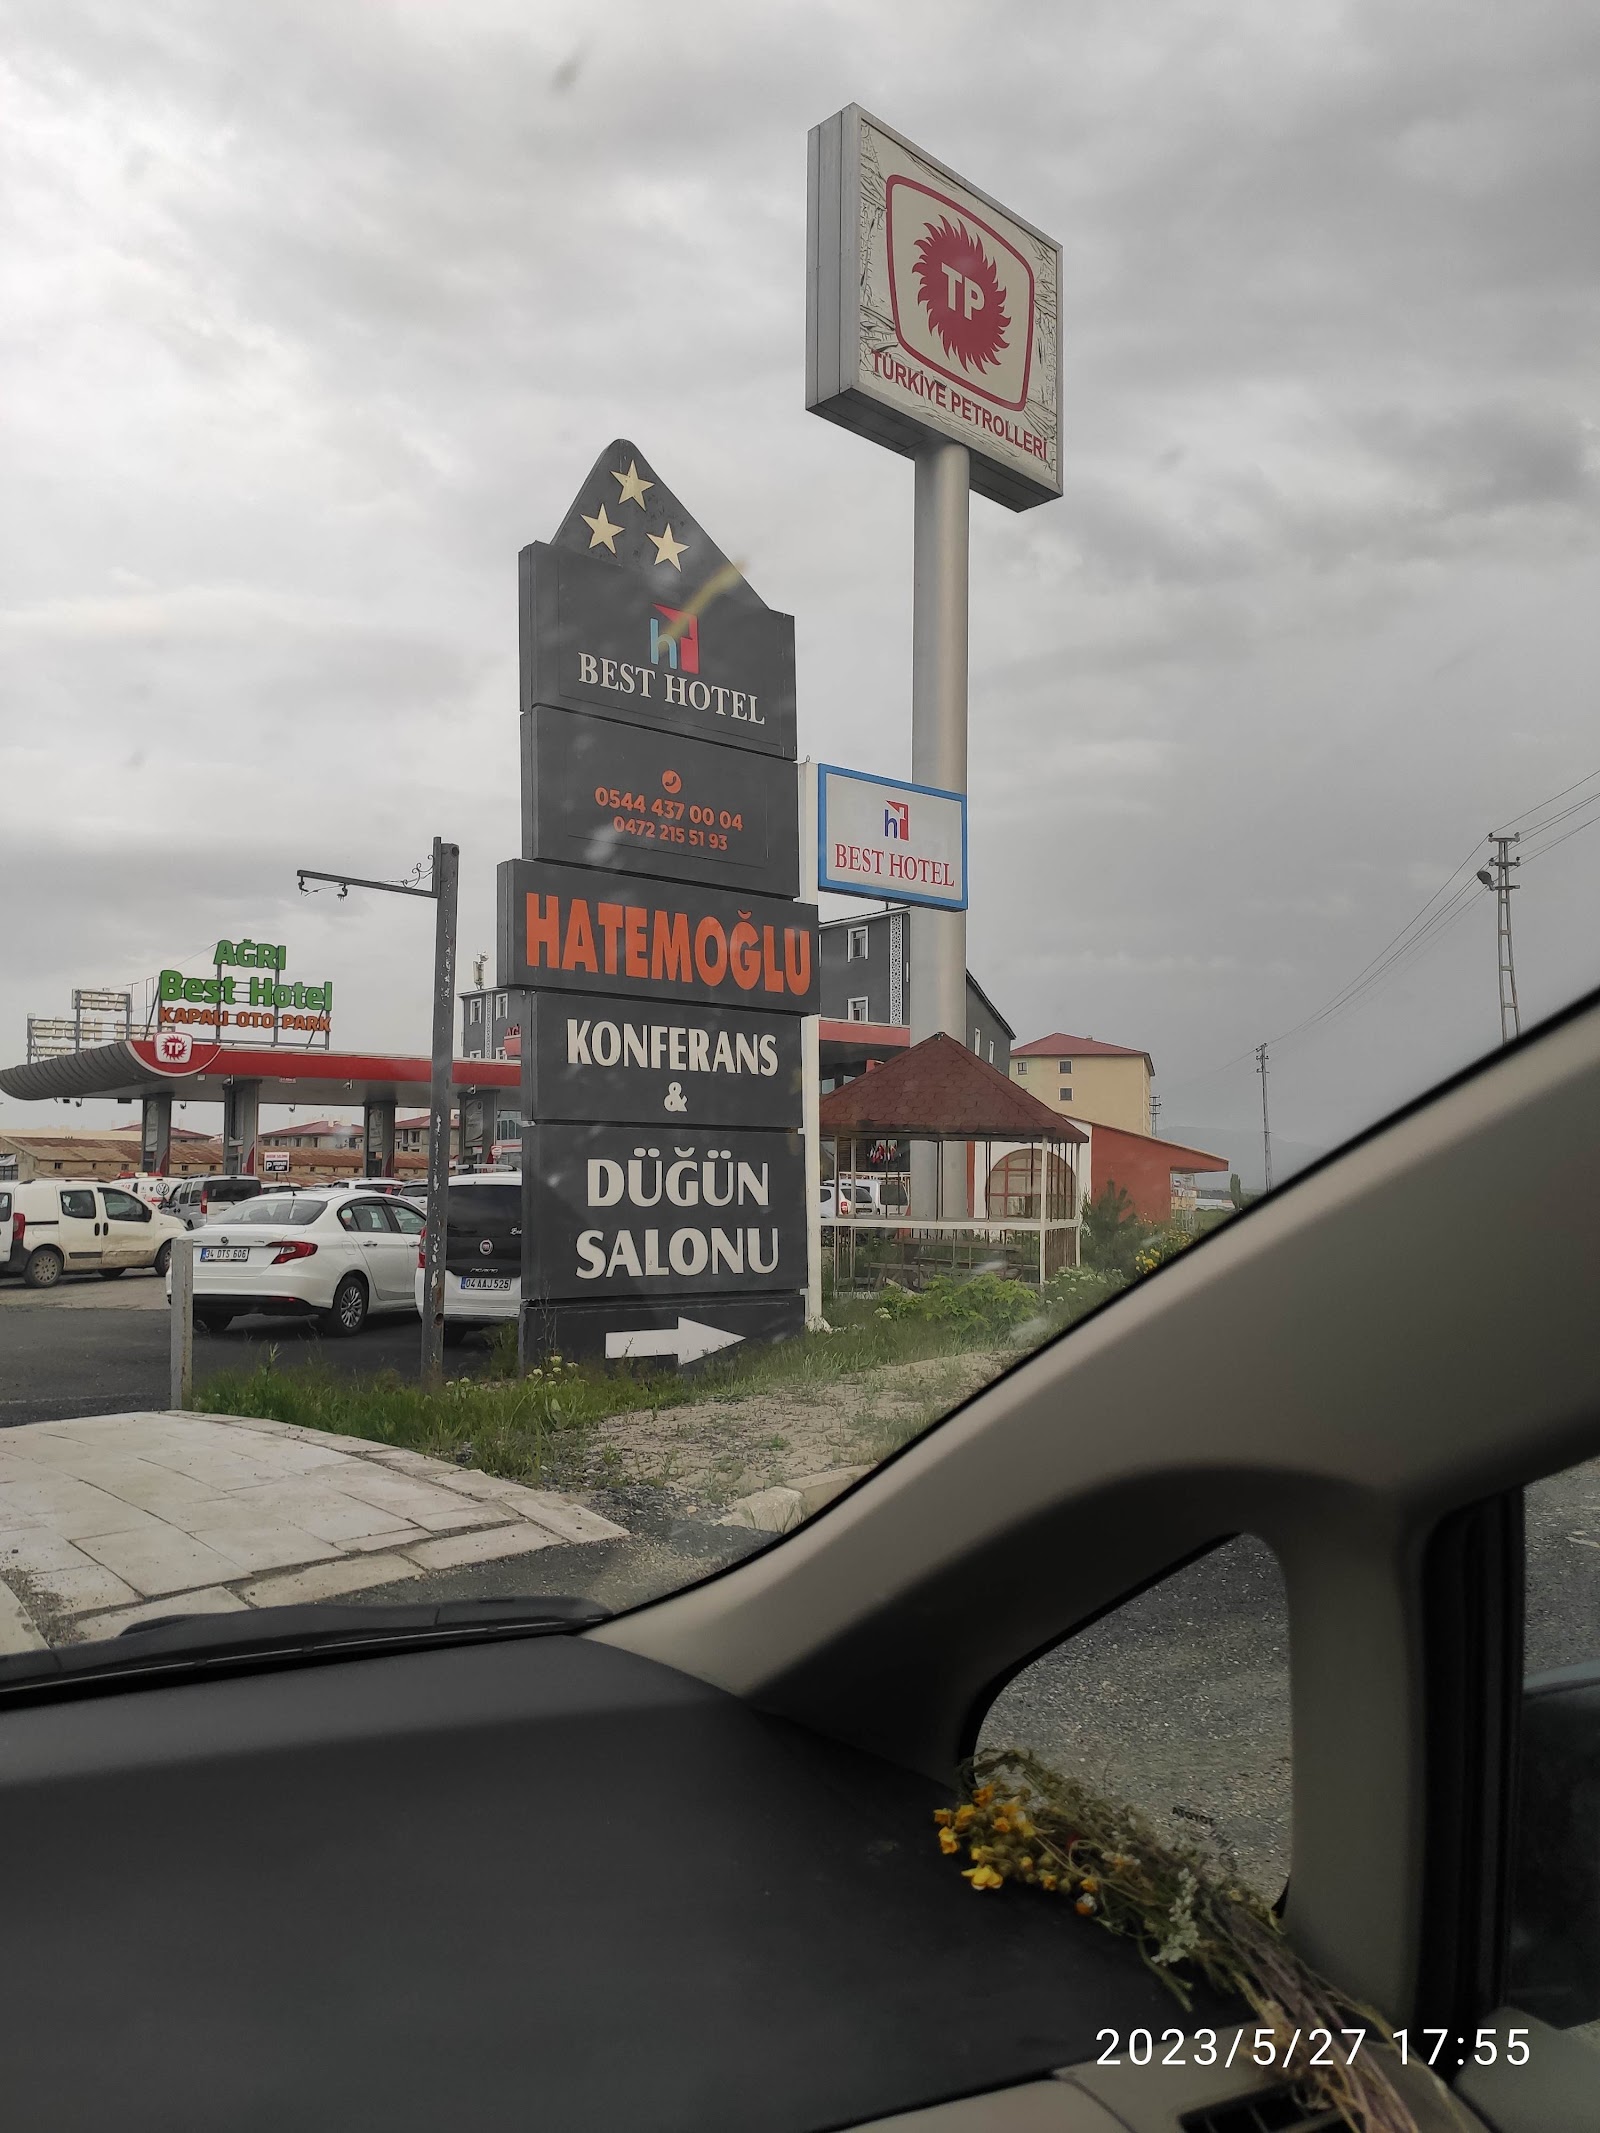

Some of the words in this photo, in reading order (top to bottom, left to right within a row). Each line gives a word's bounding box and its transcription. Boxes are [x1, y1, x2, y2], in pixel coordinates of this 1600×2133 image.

[941, 262, 986, 320] TP
[871, 350, 947, 408] TÜRKİYE
[951, 388, 1047, 461] PETROLLERİ
[578, 651, 656, 699] BEST
[664, 673, 766, 725] HOTEL
[594, 786, 647, 814] 0544
[651, 798, 686, 821] 437
[689, 805, 715, 826] 00
[719, 810, 744, 831] 04
[613, 815, 656, 838] 0472
[659, 824, 685, 844] 215
[688, 829, 705, 847] 51
[708, 833, 728, 851] 93
[834, 843, 885, 875] BEST
[888, 852, 955, 887] HOTEL
[213, 938, 287, 971] AĞRI
[525, 892, 811, 996] HATEMOĞLU
[159, 969, 237, 1006] Best
[249, 981, 333, 1012] Hotel
[158, 1006, 229, 1027] KAPALI
[236, 1011, 275, 1029] OTO
[281, 1014, 332, 1033] PARK
[166, 1042, 183, 1056] TP
[566, 1018, 779, 1077] KONFERANS
[663, 1081, 688, 1112] &
[586, 1146, 770, 1208] DÜĞÜN
[206, 1249, 214, 1259] 34
[575, 1226, 779, 1280] SALONU
[465, 1278, 476, 1289] 04
[477, 1278, 493, 1289] AAJ
[493, 1278, 510, 1289] 525
